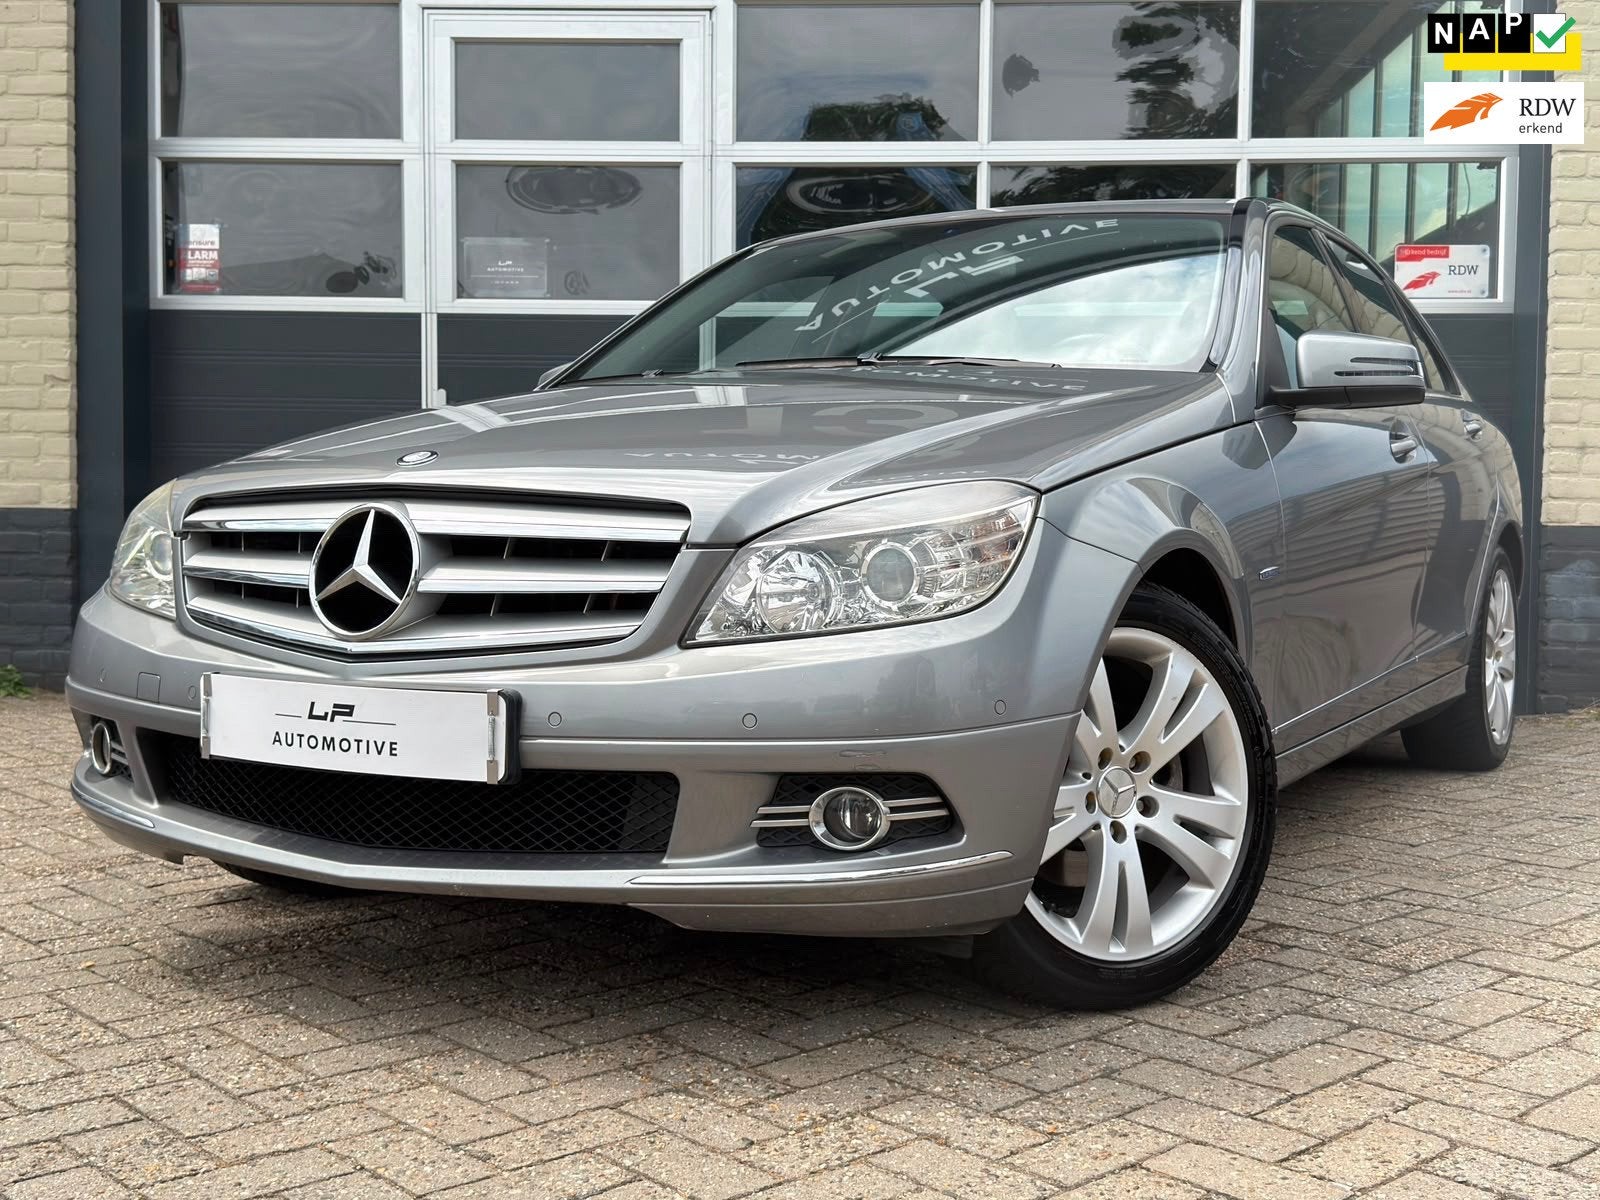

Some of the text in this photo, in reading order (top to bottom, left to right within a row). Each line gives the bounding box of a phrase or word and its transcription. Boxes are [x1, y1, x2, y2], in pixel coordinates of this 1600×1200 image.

[1448, 265, 1479, 275] RDW
[307, 701, 355, 722] LP
[272, 731, 398, 757] AUTOMOTIVE
